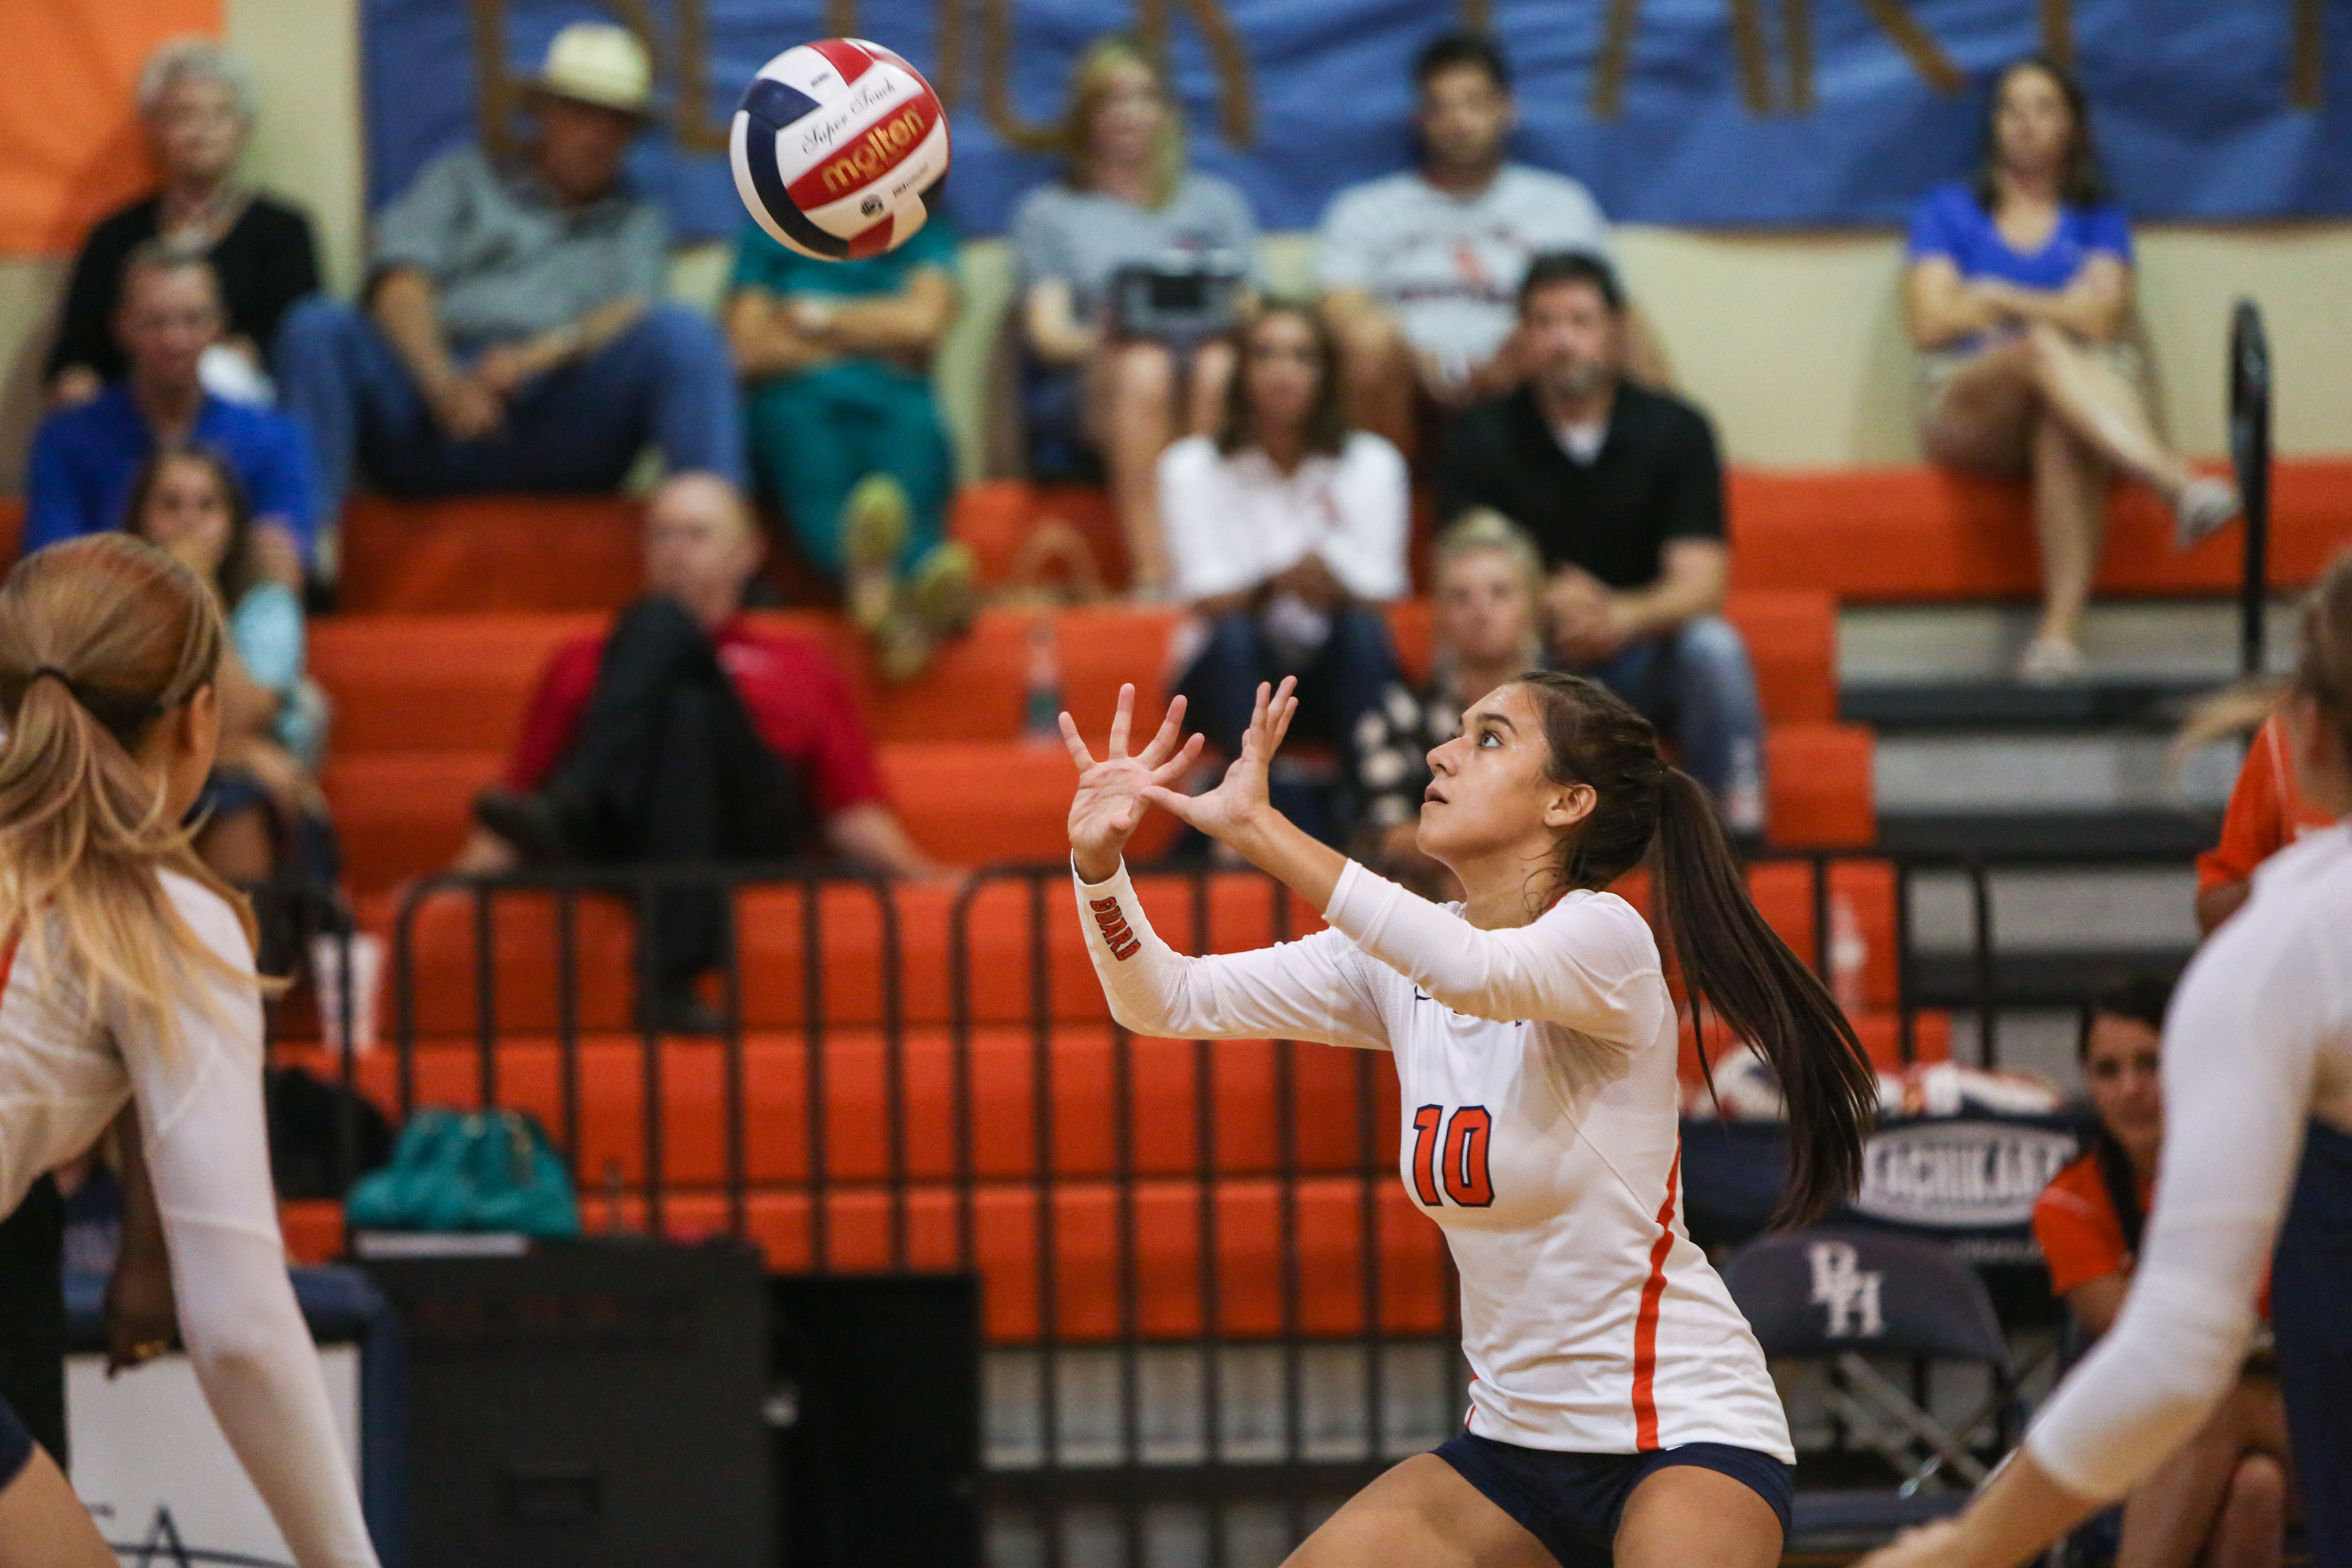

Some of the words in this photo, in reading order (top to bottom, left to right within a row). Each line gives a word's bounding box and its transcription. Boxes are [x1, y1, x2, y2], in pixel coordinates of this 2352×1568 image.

[802, 113, 847, 154] Super
[850, 76, 895, 116] Touch
[822, 109, 925, 192] molten
[1090, 896, 1141, 961] GUARD
[1413, 1104, 1495, 1207] 10
